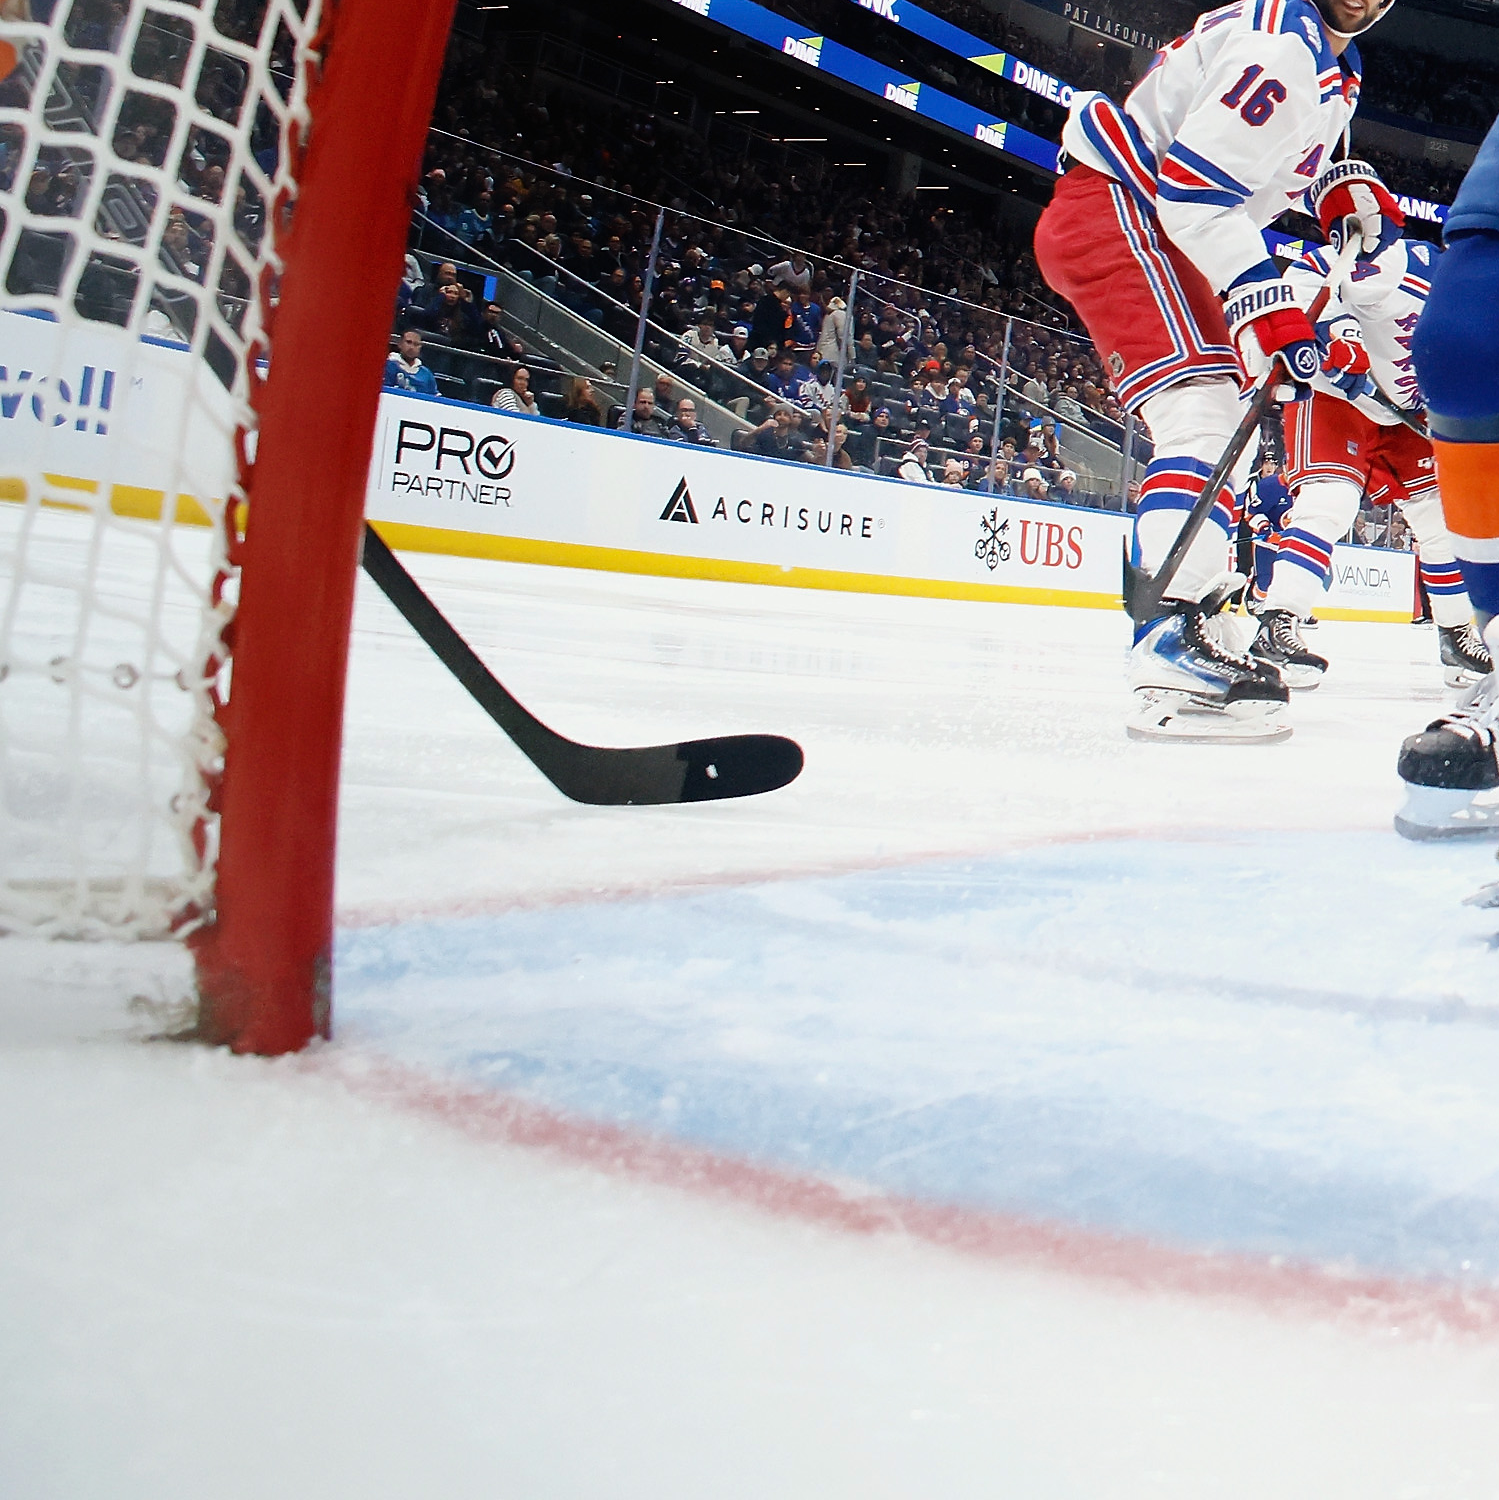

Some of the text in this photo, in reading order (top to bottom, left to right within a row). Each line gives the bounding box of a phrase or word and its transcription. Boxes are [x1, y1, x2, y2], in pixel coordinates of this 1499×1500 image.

[1063, 2, 1089, 24] PAT
[1096, 18, 1168, 52] LAFONTAI
[782, 38, 823, 69] DIME
[885, 83, 919, 113] DIME
[1013, 60, 1074, 108] DIME.C
[1221, 63, 1288, 127] 16
[975, 123, 1007, 151] DIME
[1275, 243, 1304, 261] DIME
[391, 471, 513, 509] PARTNER
[711, 496, 875, 542] ACRISURE
[1019, 519, 1084, 571] UBS
[1336, 563, 1393, 589] VANDA
